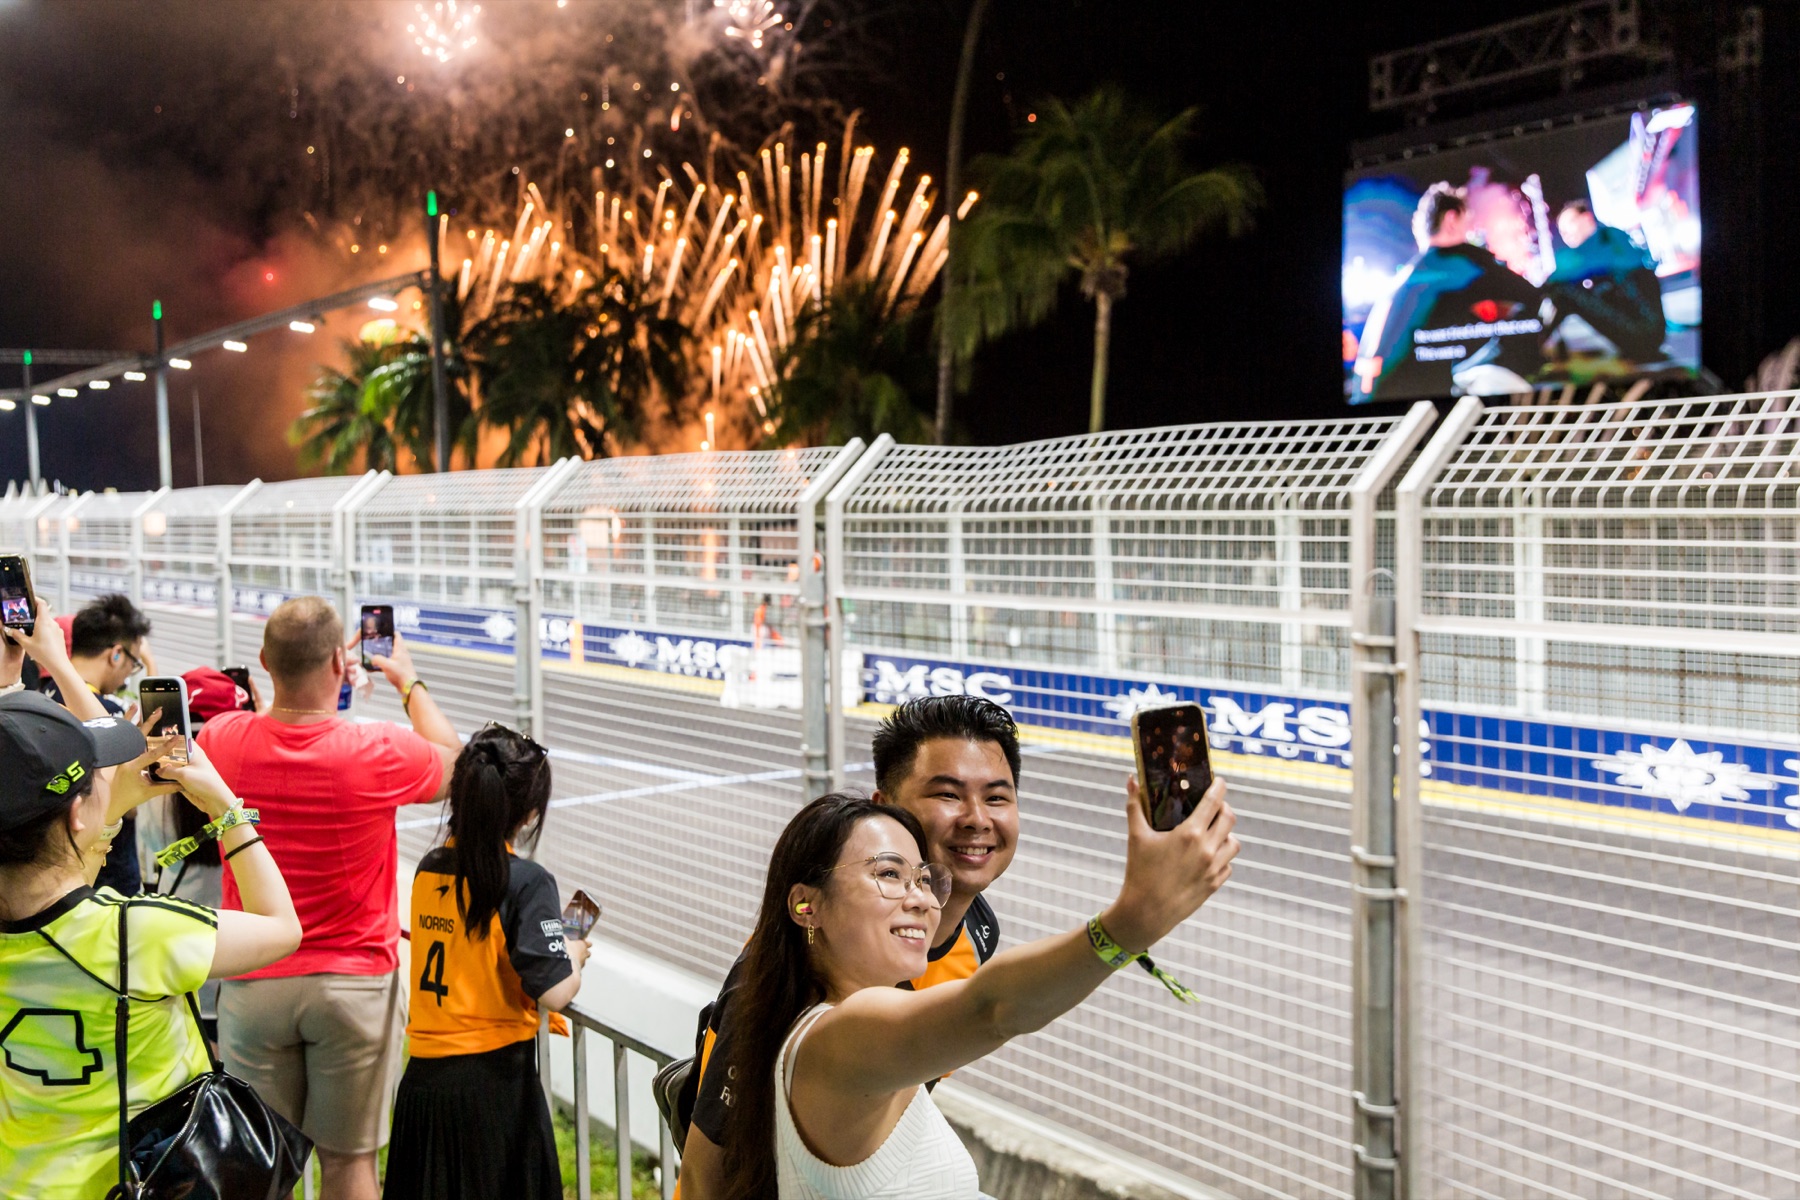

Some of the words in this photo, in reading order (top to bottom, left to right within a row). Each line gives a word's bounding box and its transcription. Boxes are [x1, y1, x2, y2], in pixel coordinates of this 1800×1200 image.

[875, 660, 1012, 704] MSC
[419, 914, 454, 933] NORRIS
[420, 940, 448, 1007] 4
